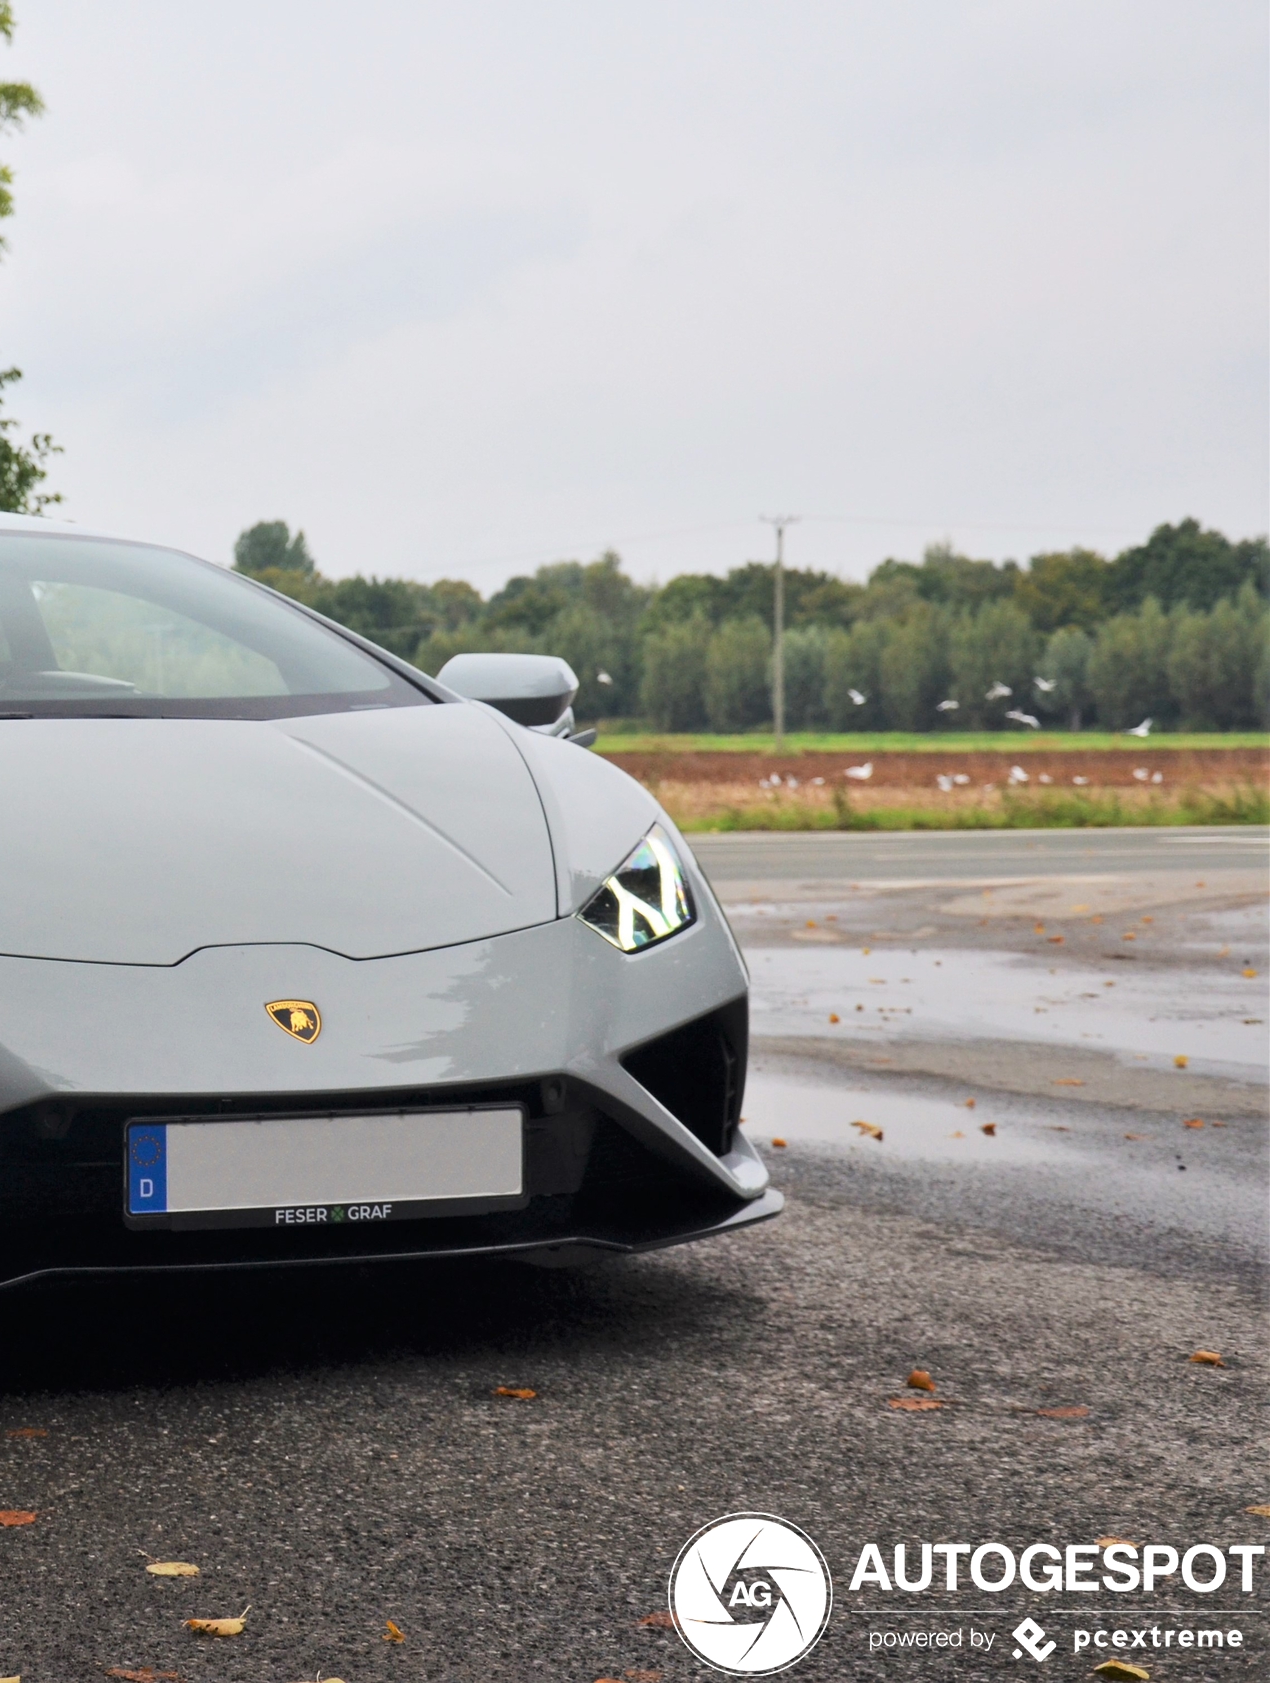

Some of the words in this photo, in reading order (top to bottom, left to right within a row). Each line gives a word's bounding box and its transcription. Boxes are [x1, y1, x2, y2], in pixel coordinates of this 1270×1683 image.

[139, 1179, 154, 1197] D
[275, 1208, 328, 1224] FESER
[347, 1204, 393, 1221] GRAF
